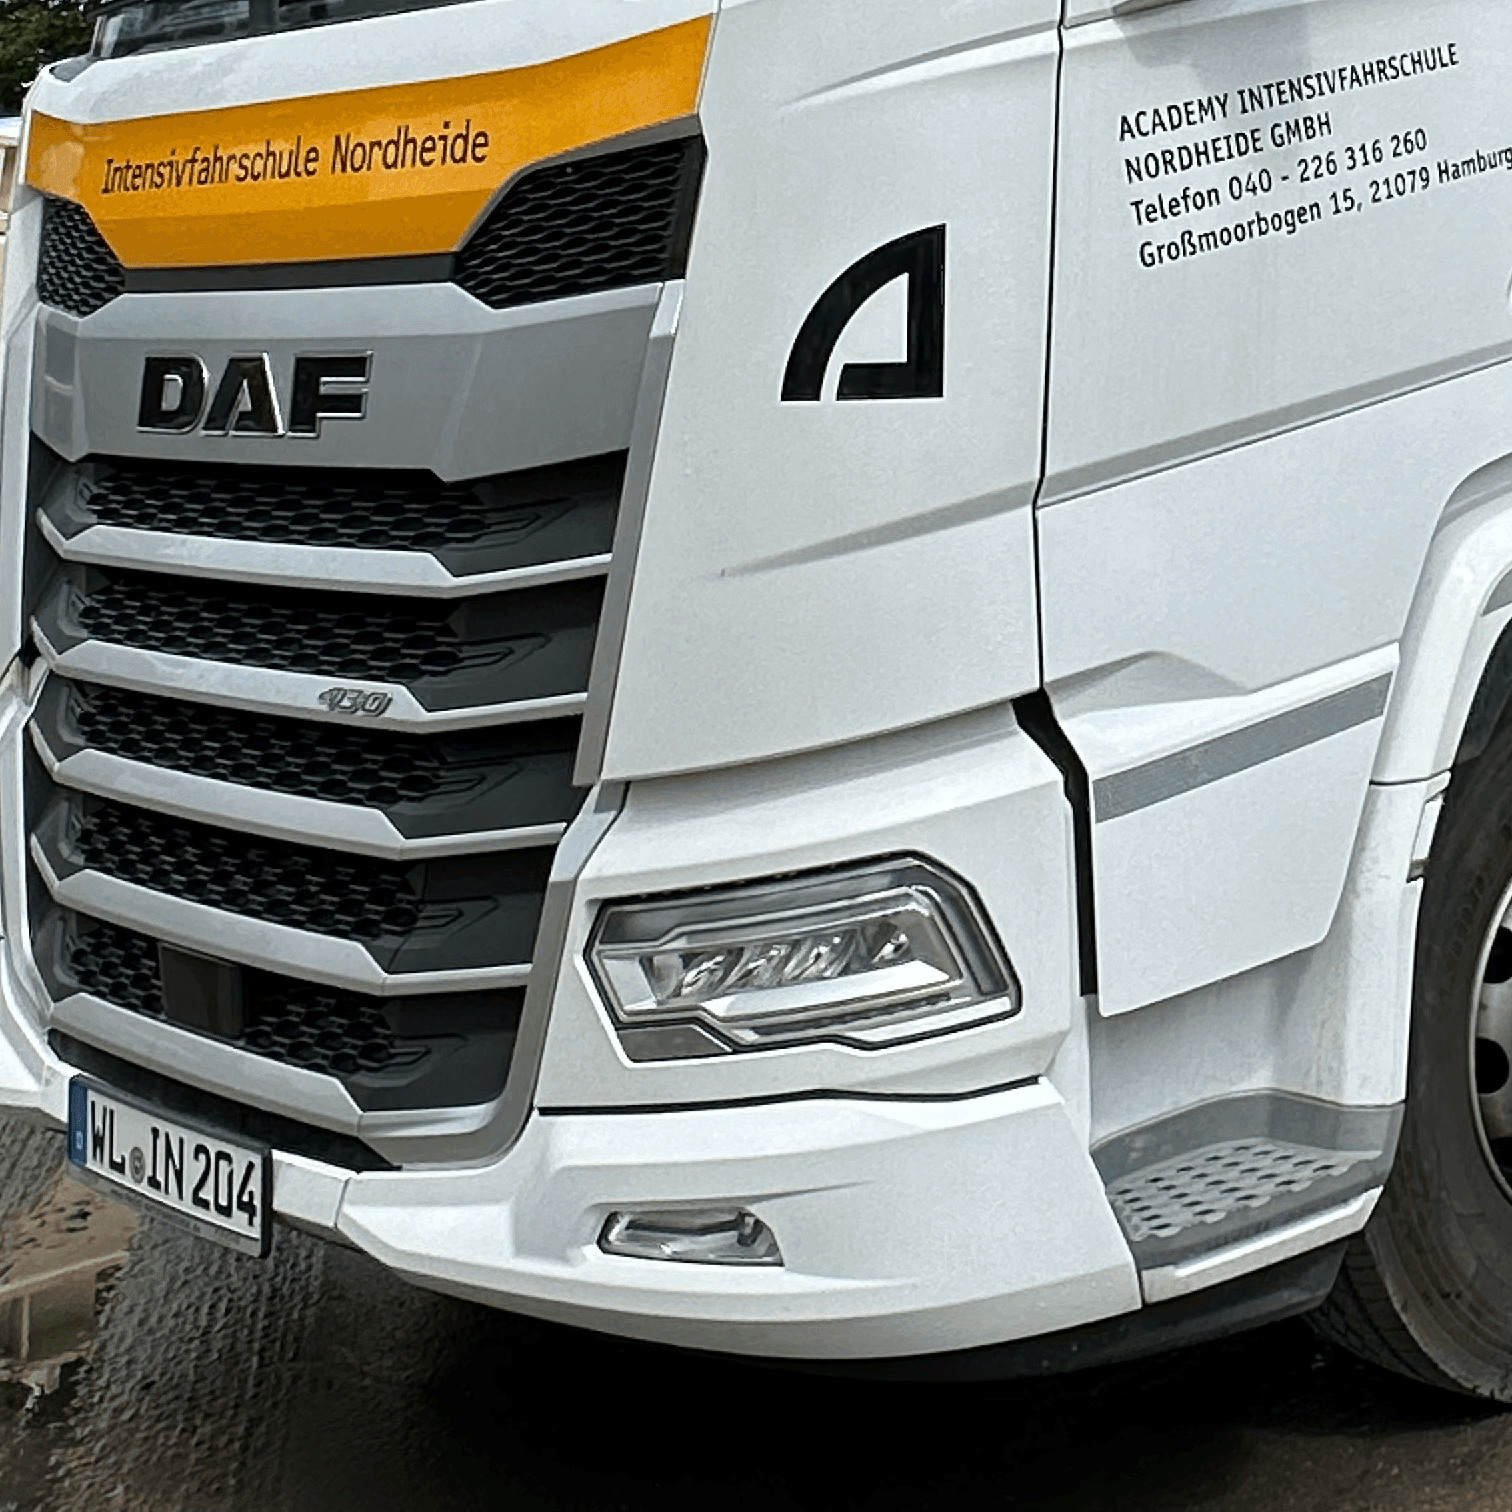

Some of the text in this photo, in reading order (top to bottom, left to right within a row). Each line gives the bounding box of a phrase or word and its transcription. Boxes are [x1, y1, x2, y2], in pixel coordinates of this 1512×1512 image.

[1119, 43, 1460, 142] ACADEMY INTENSIVFAHRSCHULE
[101, 119, 490, 195] Intensivfahrschule Nordheide
[1124, 111, 1333, 184] NORDHEIDE GMBH
[1130, 184, 1221, 226] Telefon
[1228, 168, 1273, 202] 040
[1298, 153, 1339, 184] 226
[1344, 140, 1384, 172] 316
[1390, 127, 1428, 159] 260
[1139, 199, 1322, 268] Großmoorbogen
[1329, 189, 1364, 217] 15,
[1369, 166, 1431, 205] 21079
[137, 349, 374, 439] DAF
[90, 1100, 126, 1175] WL
[191, 1143, 257, 1227] 204
